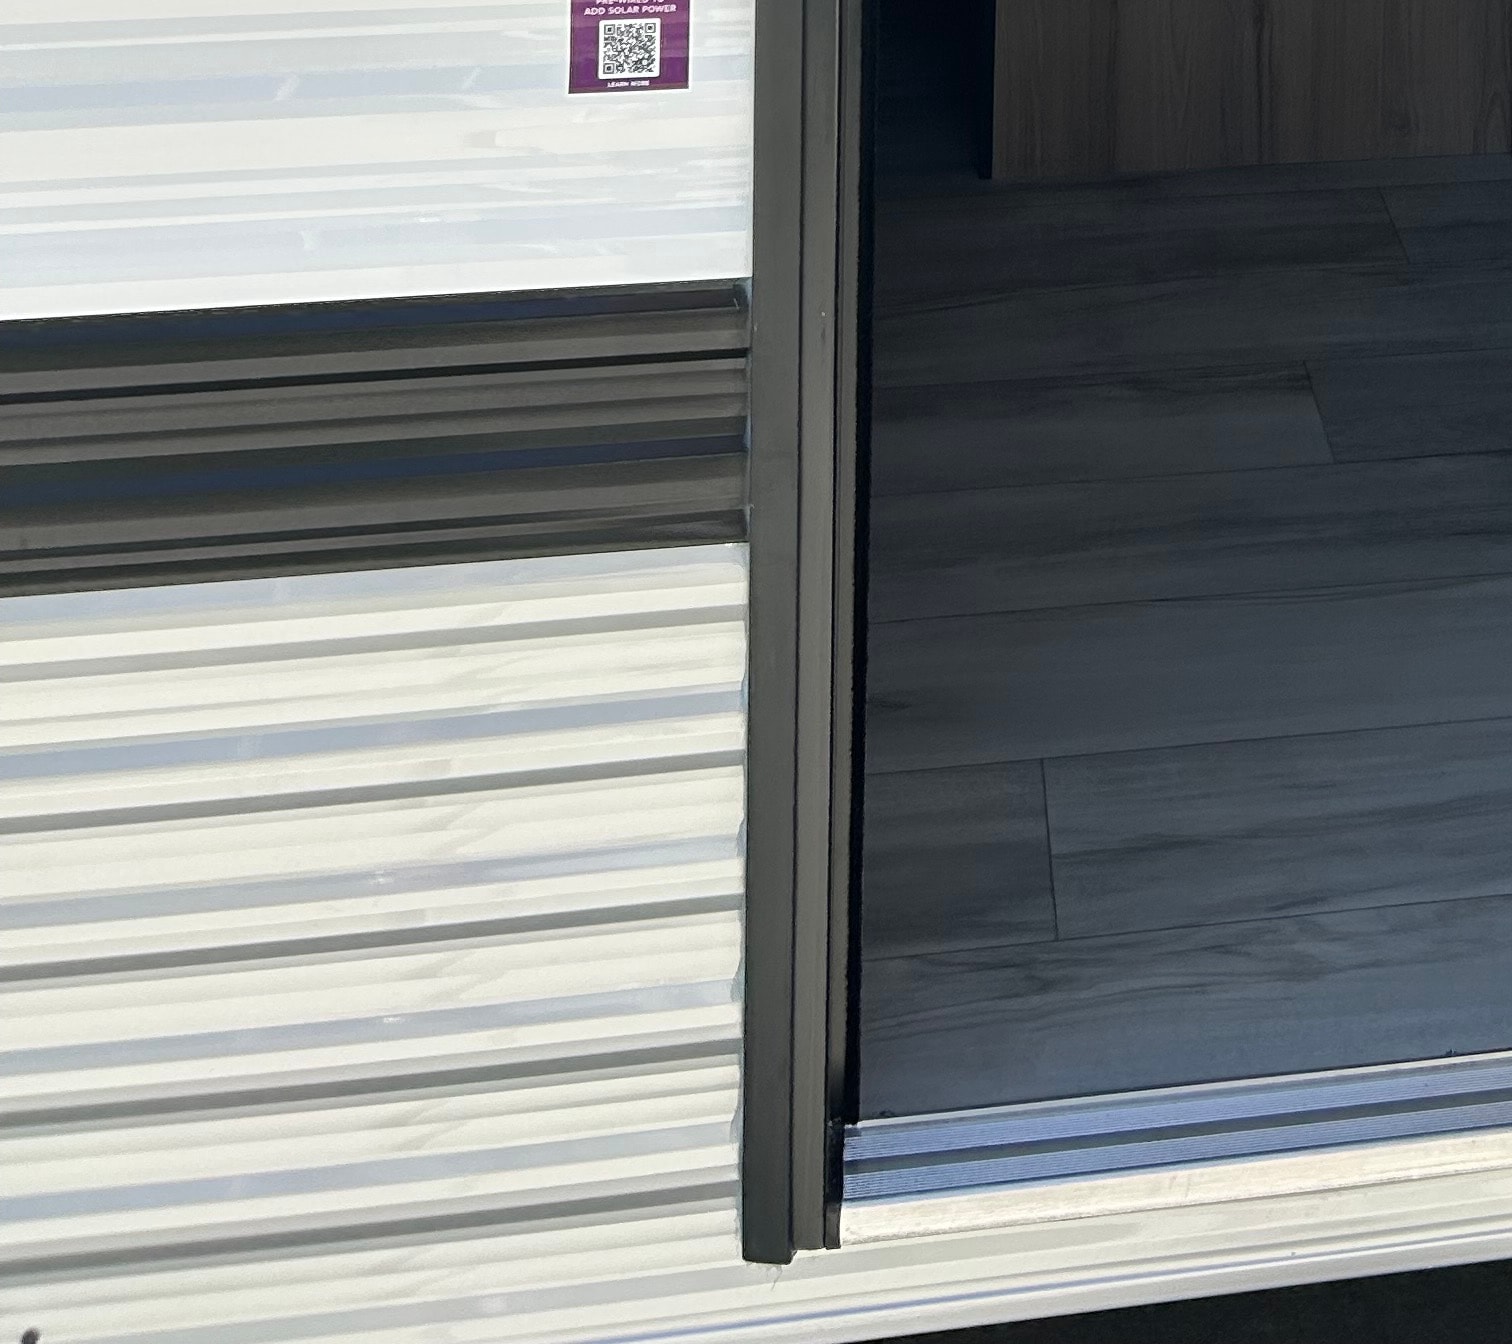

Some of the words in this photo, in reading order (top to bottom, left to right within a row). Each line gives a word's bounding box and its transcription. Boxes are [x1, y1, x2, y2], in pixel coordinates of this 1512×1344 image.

[583, 7, 606, 16] ADD
[608, 5, 640, 15] SOLAR
[642, 4, 677, 14] POWER
